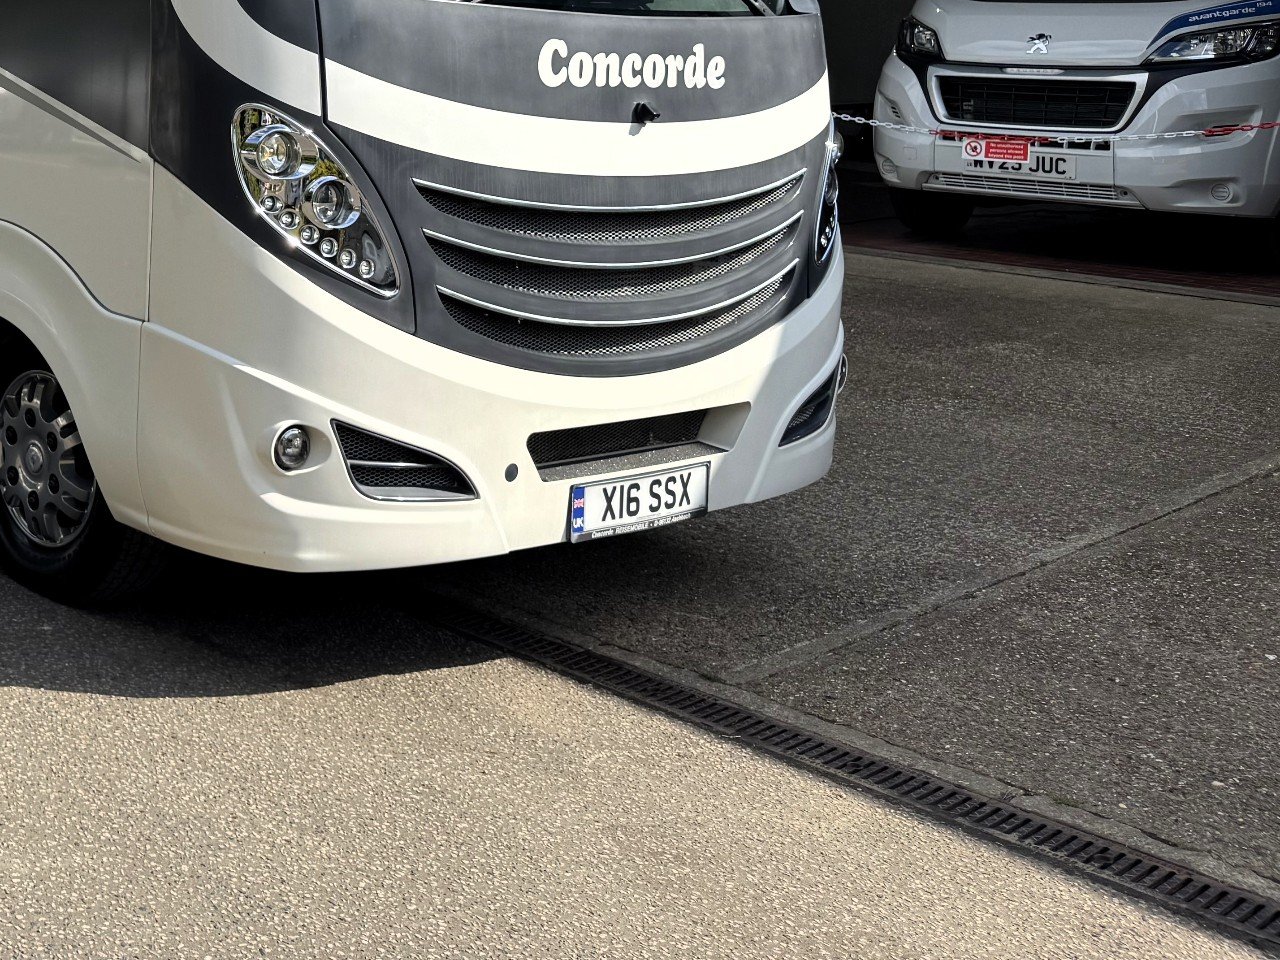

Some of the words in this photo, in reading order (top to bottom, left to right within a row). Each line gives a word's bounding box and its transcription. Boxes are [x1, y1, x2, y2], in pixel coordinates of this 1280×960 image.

[1188, 7, 1256, 22] avantgarde
[537, 38, 726, 90] Concorde
[1029, 156, 1067, 175] JUC
[601, 483, 641, 522] X16
[648, 472, 692, 513] SSX
[572, 516, 584, 529] UK
